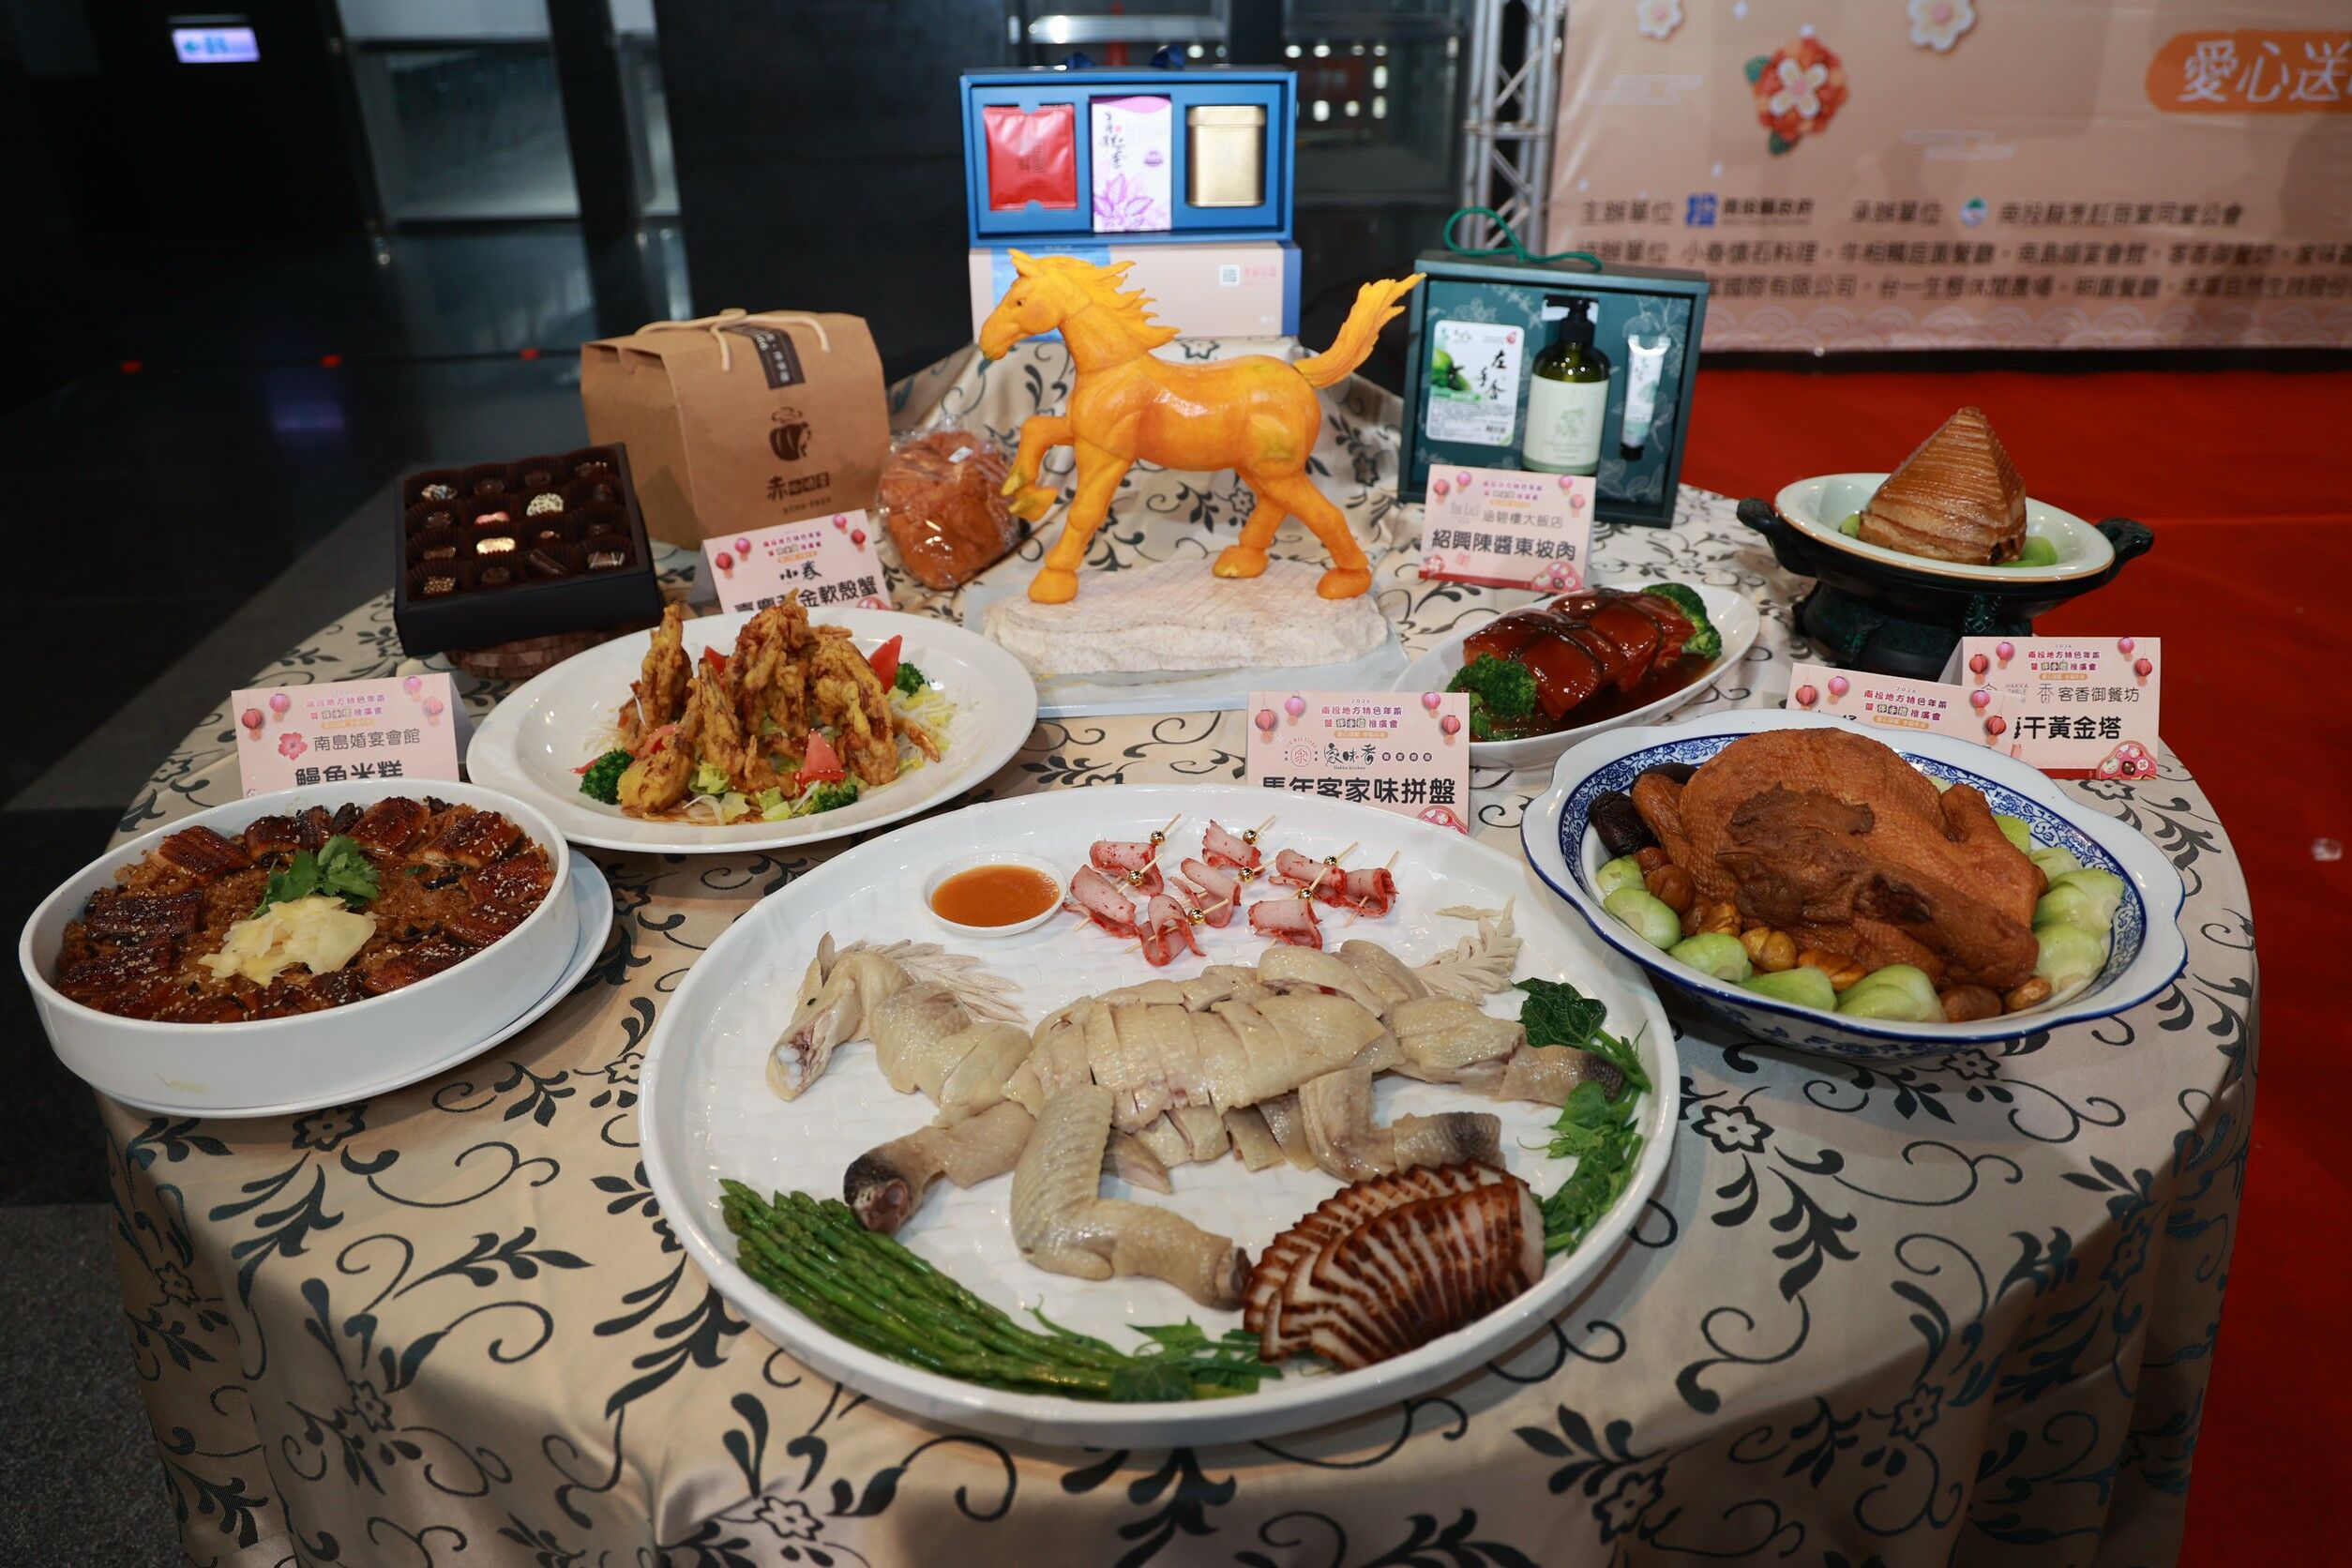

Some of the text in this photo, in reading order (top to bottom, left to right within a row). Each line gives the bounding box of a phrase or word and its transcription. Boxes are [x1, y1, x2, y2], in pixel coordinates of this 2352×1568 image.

[2178, 39, 2352, 103] 愛心送
[1483, 509, 1563, 529] 涵碧樓大飯店
[1432, 529, 1576, 561] 紹興陳醬東坡肉
[1863, 689, 1948, 709] 南投地方特色年菜
[2058, 686, 2139, 703] 客香御餐坊
[1321, 705, 1402, 716] 南投地方特色年菜
[313, 727, 420, 752] 南島婚宴會館
